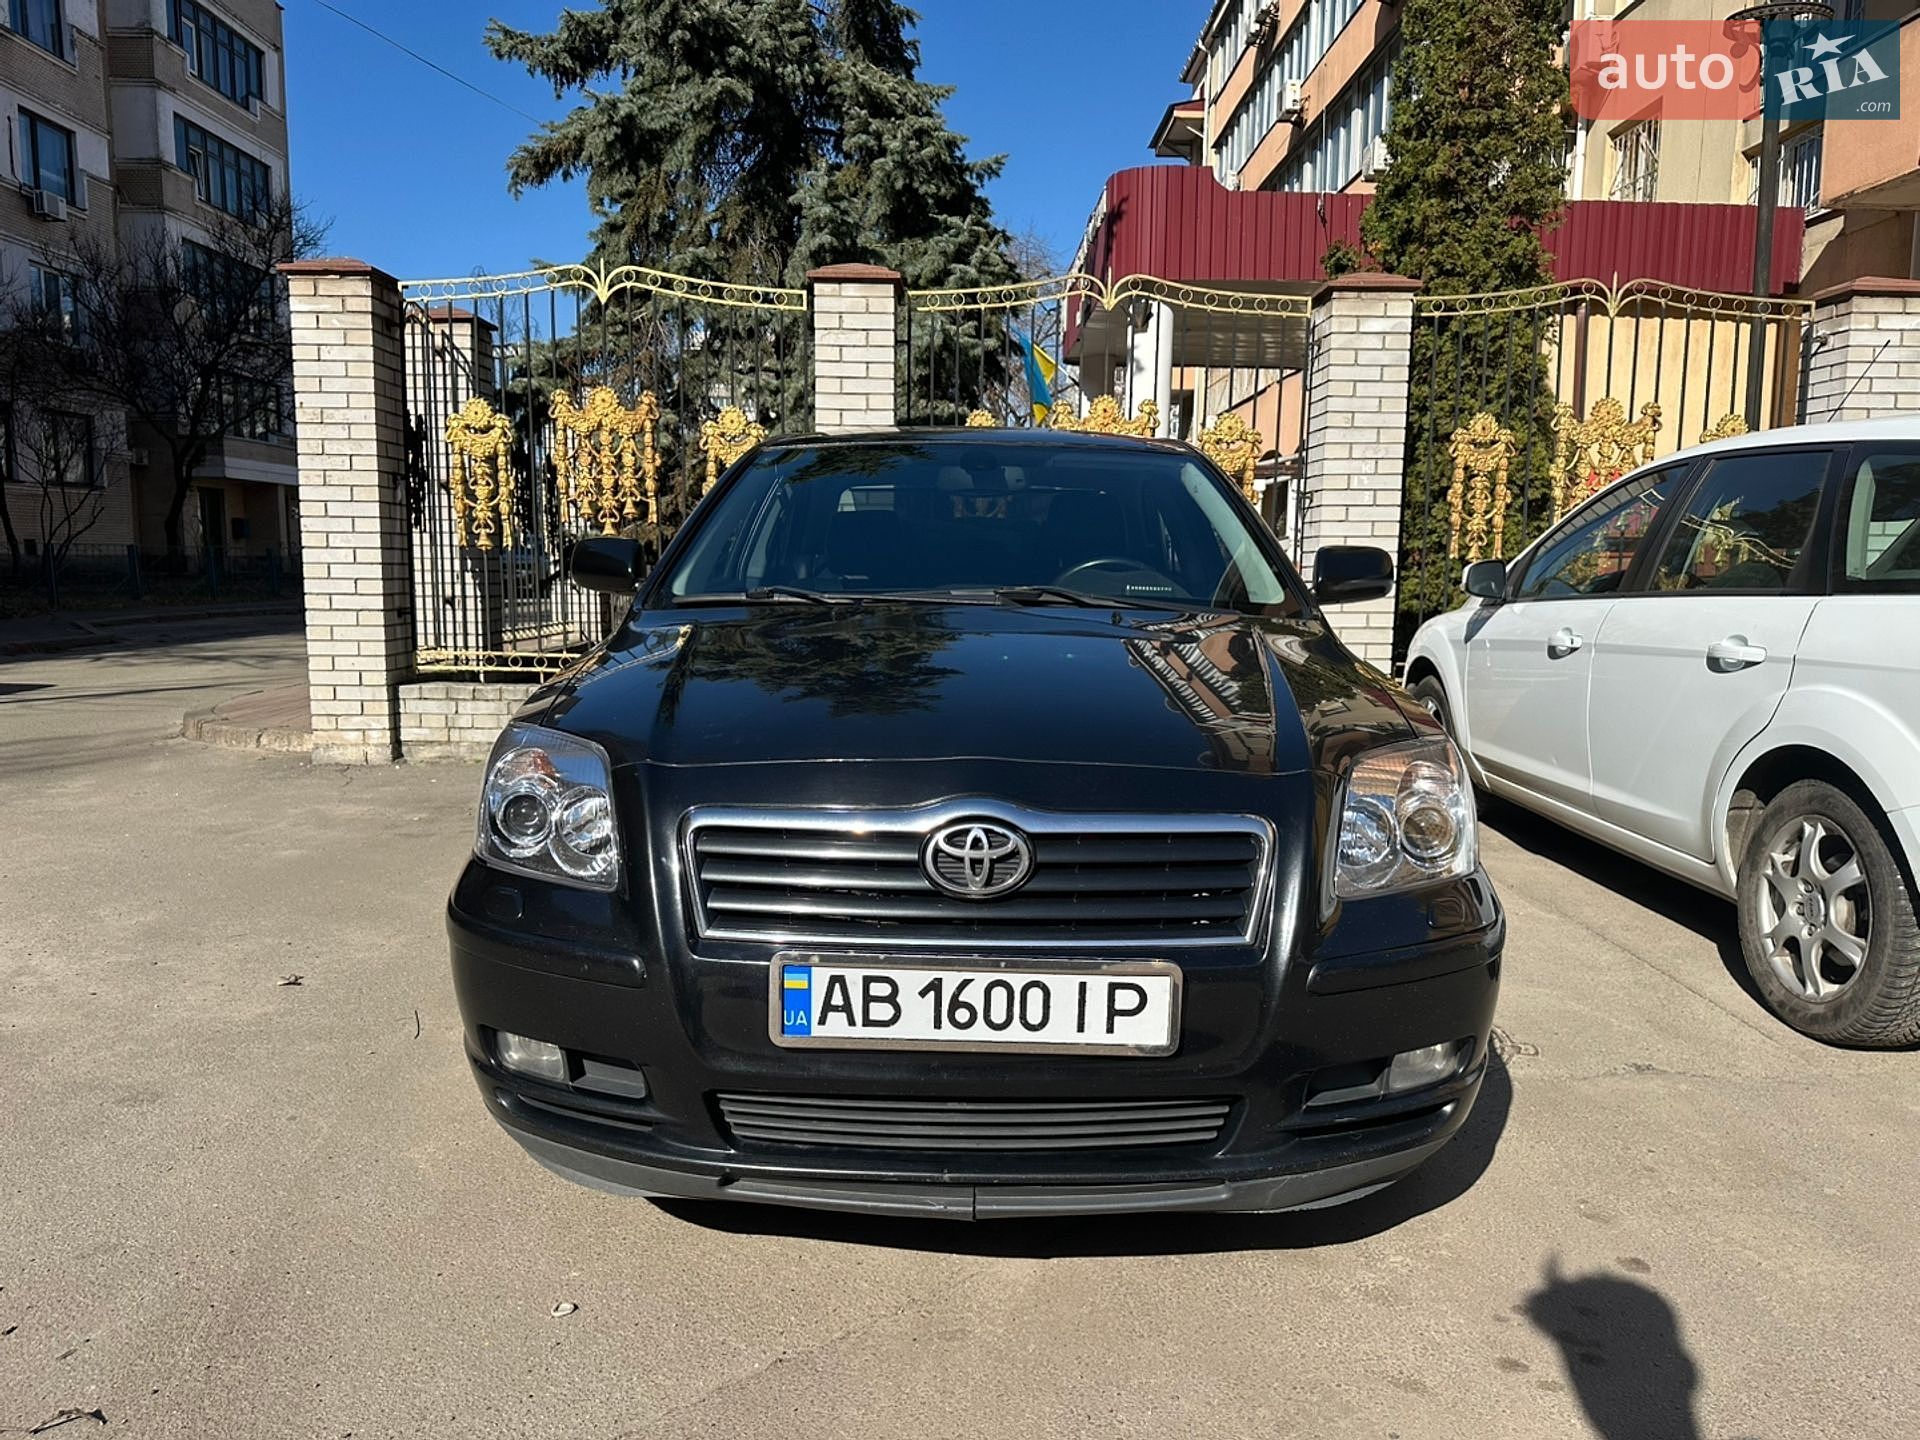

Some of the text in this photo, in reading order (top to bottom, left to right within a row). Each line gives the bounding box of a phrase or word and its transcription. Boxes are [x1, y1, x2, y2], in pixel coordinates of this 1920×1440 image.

[783, 1009, 808, 1027] UA
[817, 974, 1149, 1035] AB 1600 IP
